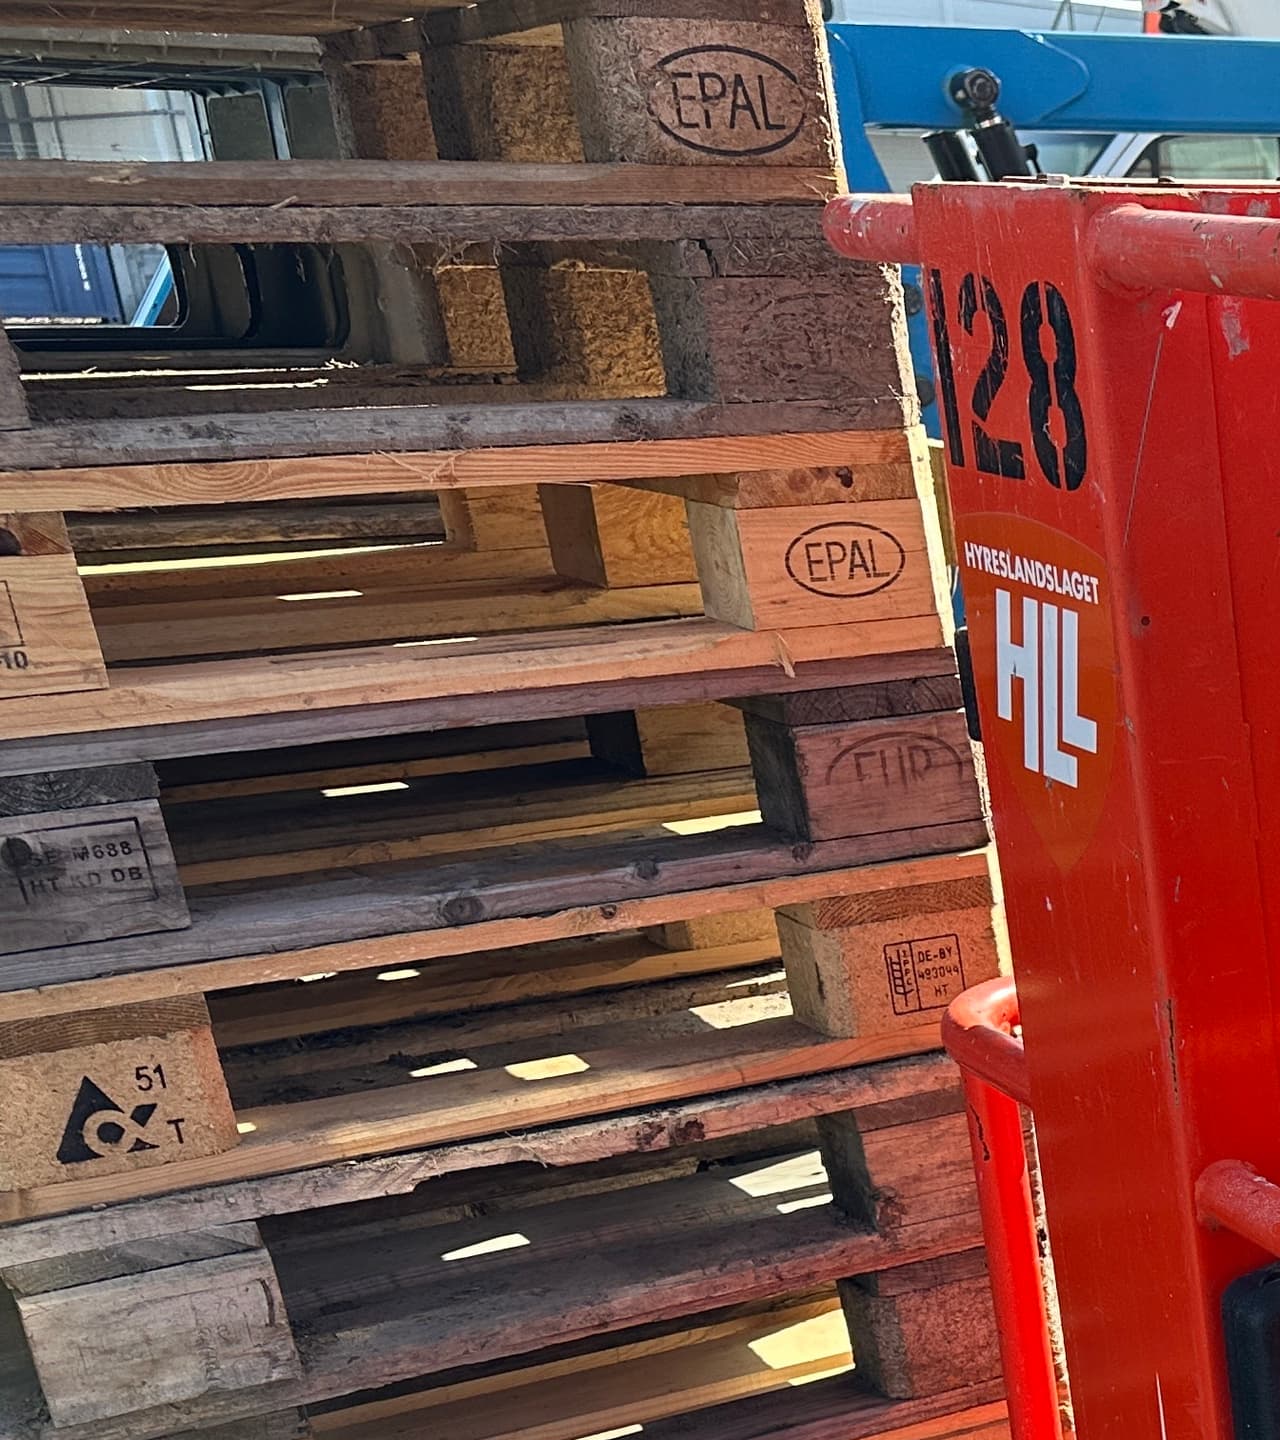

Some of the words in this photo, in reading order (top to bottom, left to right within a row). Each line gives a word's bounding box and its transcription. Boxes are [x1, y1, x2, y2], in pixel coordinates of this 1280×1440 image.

[671, 71, 786, 131] EPAL
[930, 266, 1088, 491] 128
[803, 538, 891, 583] EPAL
[963, 540, 1100, 606] HYRESLANDSLAGET
[111, 865, 144, 884] DB
[917, 946, 953, 963] DE-BY
[934, 983, 949, 998] HT
[135, 1063, 167, 1092] 51
[166, 1118, 186, 1145] T
